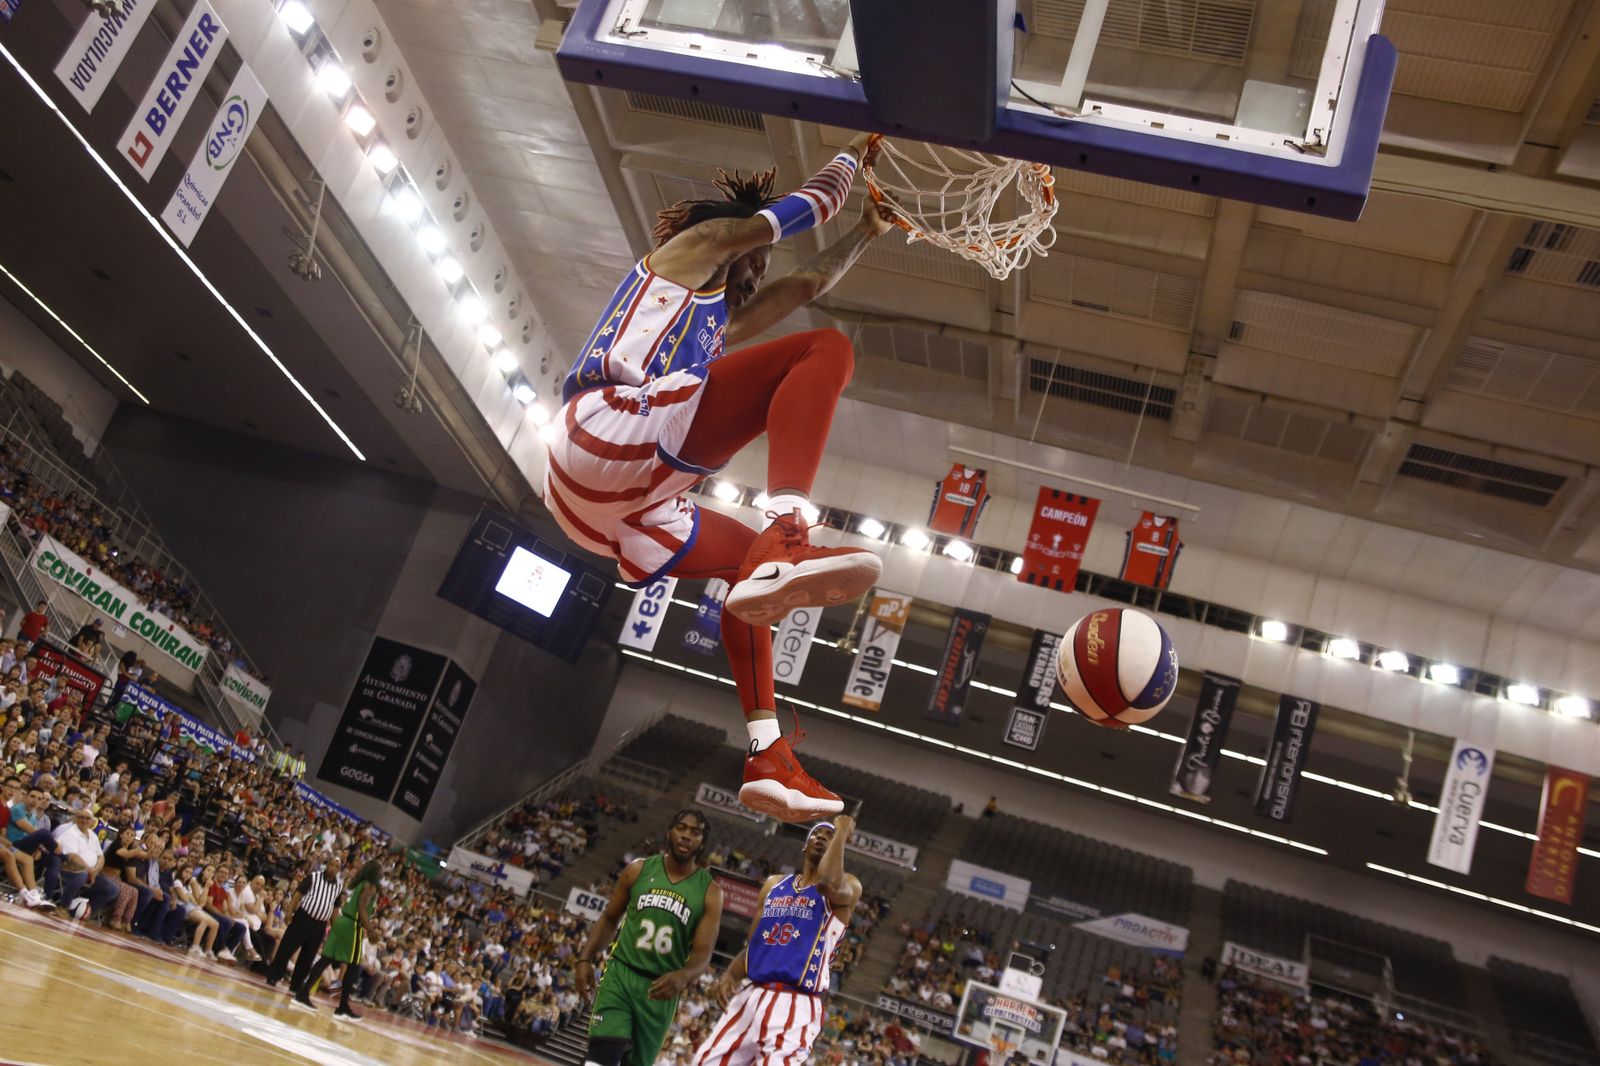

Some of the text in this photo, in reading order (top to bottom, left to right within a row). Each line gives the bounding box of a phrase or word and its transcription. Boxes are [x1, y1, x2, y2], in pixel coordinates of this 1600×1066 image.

[145, 13, 220, 136] BERNER
[209, 103, 244, 159] GNB
[1040, 506, 1088, 527] CAMPEÓN
[776, 610, 810, 677] otero
[1029, 634, 1055, 688] DE VERDAD
[40, 651, 96, 691] AYUTAMIENTO
[362, 674, 428, 702] AYUNTAMIENTO
[853, 645, 887, 697] enPie
[363, 688, 417, 711] DE GRANADA
[1449, 781, 1481, 846] Cuerva
[855, 834, 911, 861] DEAL
[637, 893, 691, 926] GENERALS
[635, 918, 673, 954] 26
[765, 923, 795, 946] 26
[1231, 946, 1299, 978] IDEAL
